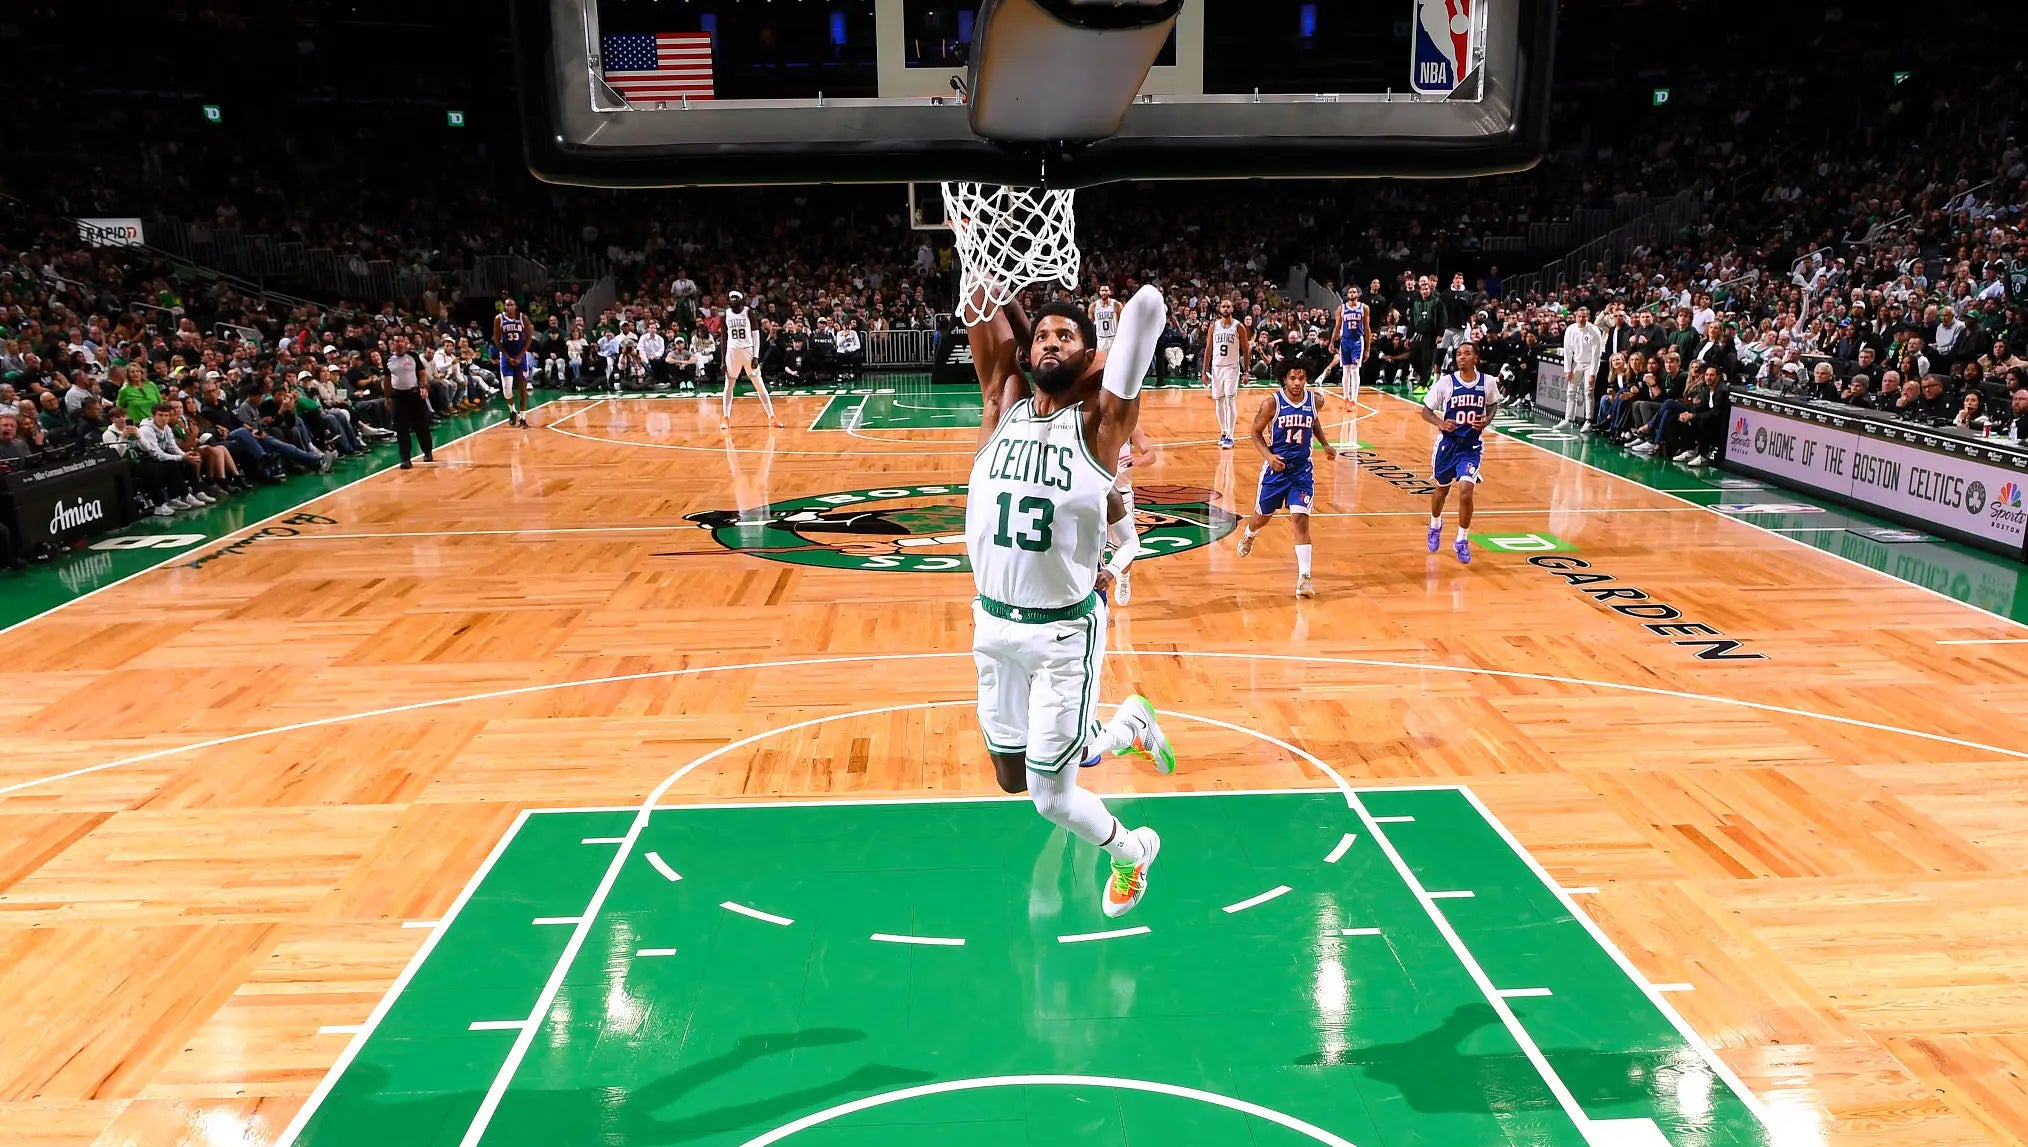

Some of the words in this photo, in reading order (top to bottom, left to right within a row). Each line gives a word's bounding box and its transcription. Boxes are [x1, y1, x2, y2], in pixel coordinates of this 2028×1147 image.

[1420, 62, 1447, 84] NBA
[951, 326, 968, 335] Ami
[1103, 320, 1110, 331] 0
[1347, 321, 1358, 330] 12
[507, 333, 520, 341] 33
[731, 329, 746, 339] 88
[1220, 344, 1228, 357] 9
[558, 392, 723, 401] BOSTON
[743, 388, 896, 397] CELTICS
[1450, 394, 1485, 409] PHILA
[1278, 415, 1313, 428] PHILA
[1455, 410, 1477, 425] 00
[1285, 429, 1304, 445] 14
[990, 438, 1074, 491] CELTICS
[1768, 431, 1797, 462] HOME
[1802, 440, 1817, 467] OF
[1824, 445, 1846, 476] THE
[1852, 452, 1901, 491] BOSTON
[1908, 467, 1963, 508] CELTICS
[1338, 451, 1438, 496] GARDEN
[49, 496, 103, 535] Amica
[1990, 501, 2026, 524] Sports
[993, 491, 1055, 552] 13
[1991, 521, 2020, 534] BOSTON
[1487, 533, 1557, 551] TD
[1526, 554, 1771, 661] GARDEN
